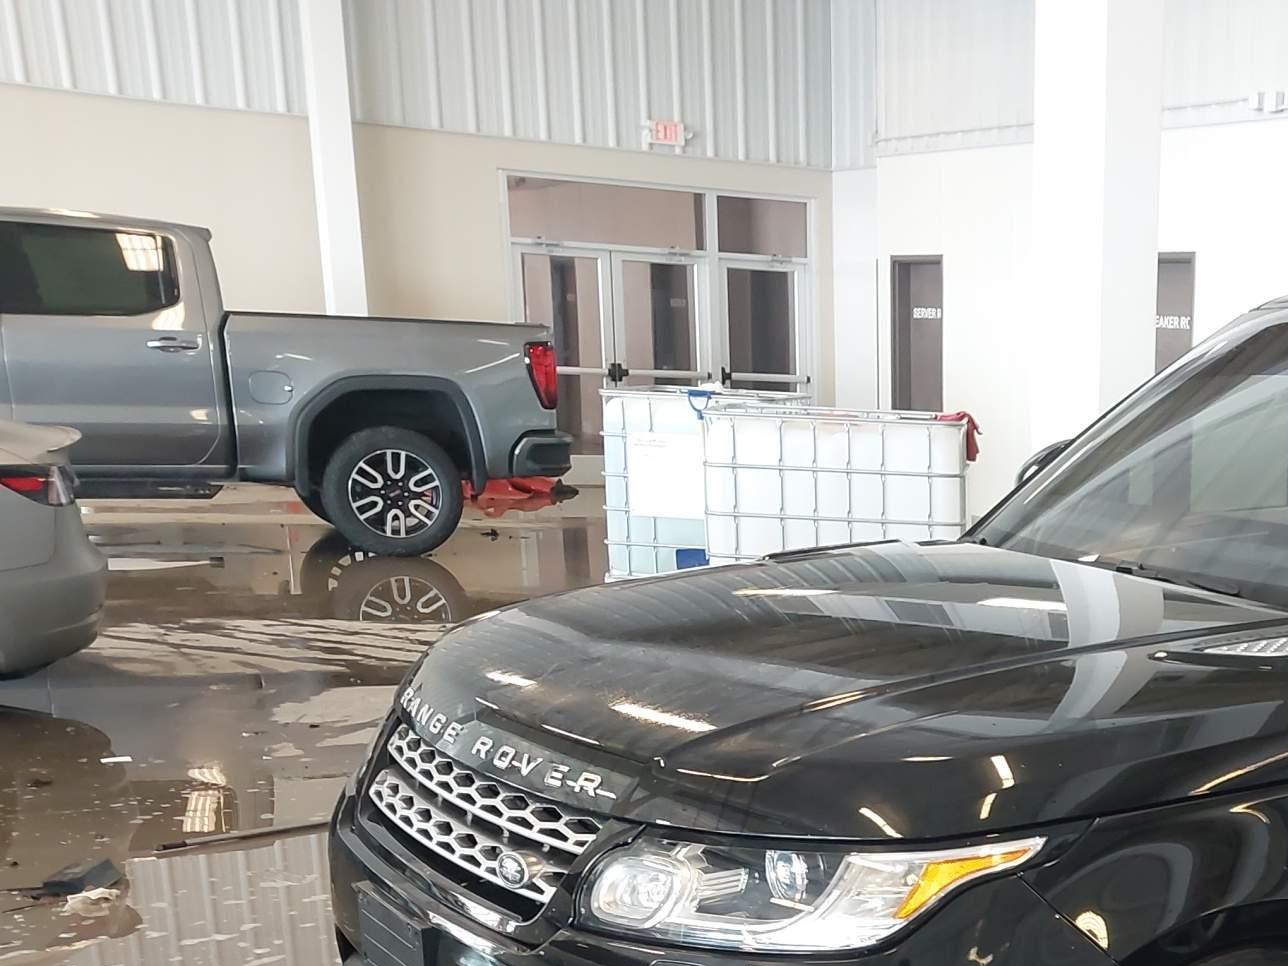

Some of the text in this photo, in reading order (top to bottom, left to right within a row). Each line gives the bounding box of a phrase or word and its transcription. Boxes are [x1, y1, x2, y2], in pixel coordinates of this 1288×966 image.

[913, 307, 936, 319] SERVER
[400, 687, 604, 798] RANGE ROVER
